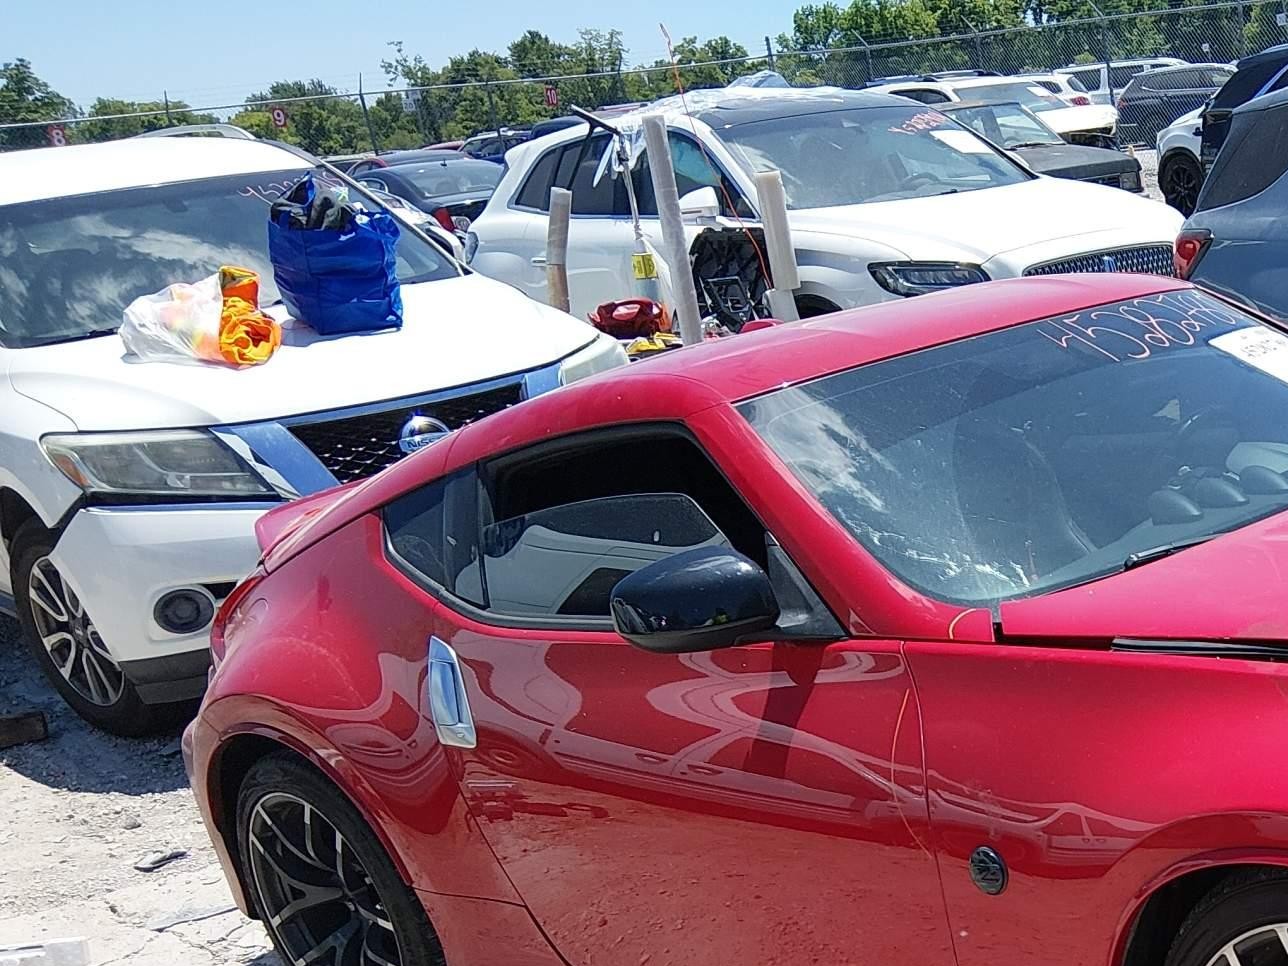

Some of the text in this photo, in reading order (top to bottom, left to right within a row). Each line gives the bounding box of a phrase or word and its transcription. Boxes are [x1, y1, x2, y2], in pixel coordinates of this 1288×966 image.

[547, 89, 557, 105] 10
[273, 109, 285, 126] 9
[51, 129, 66, 147] 8
